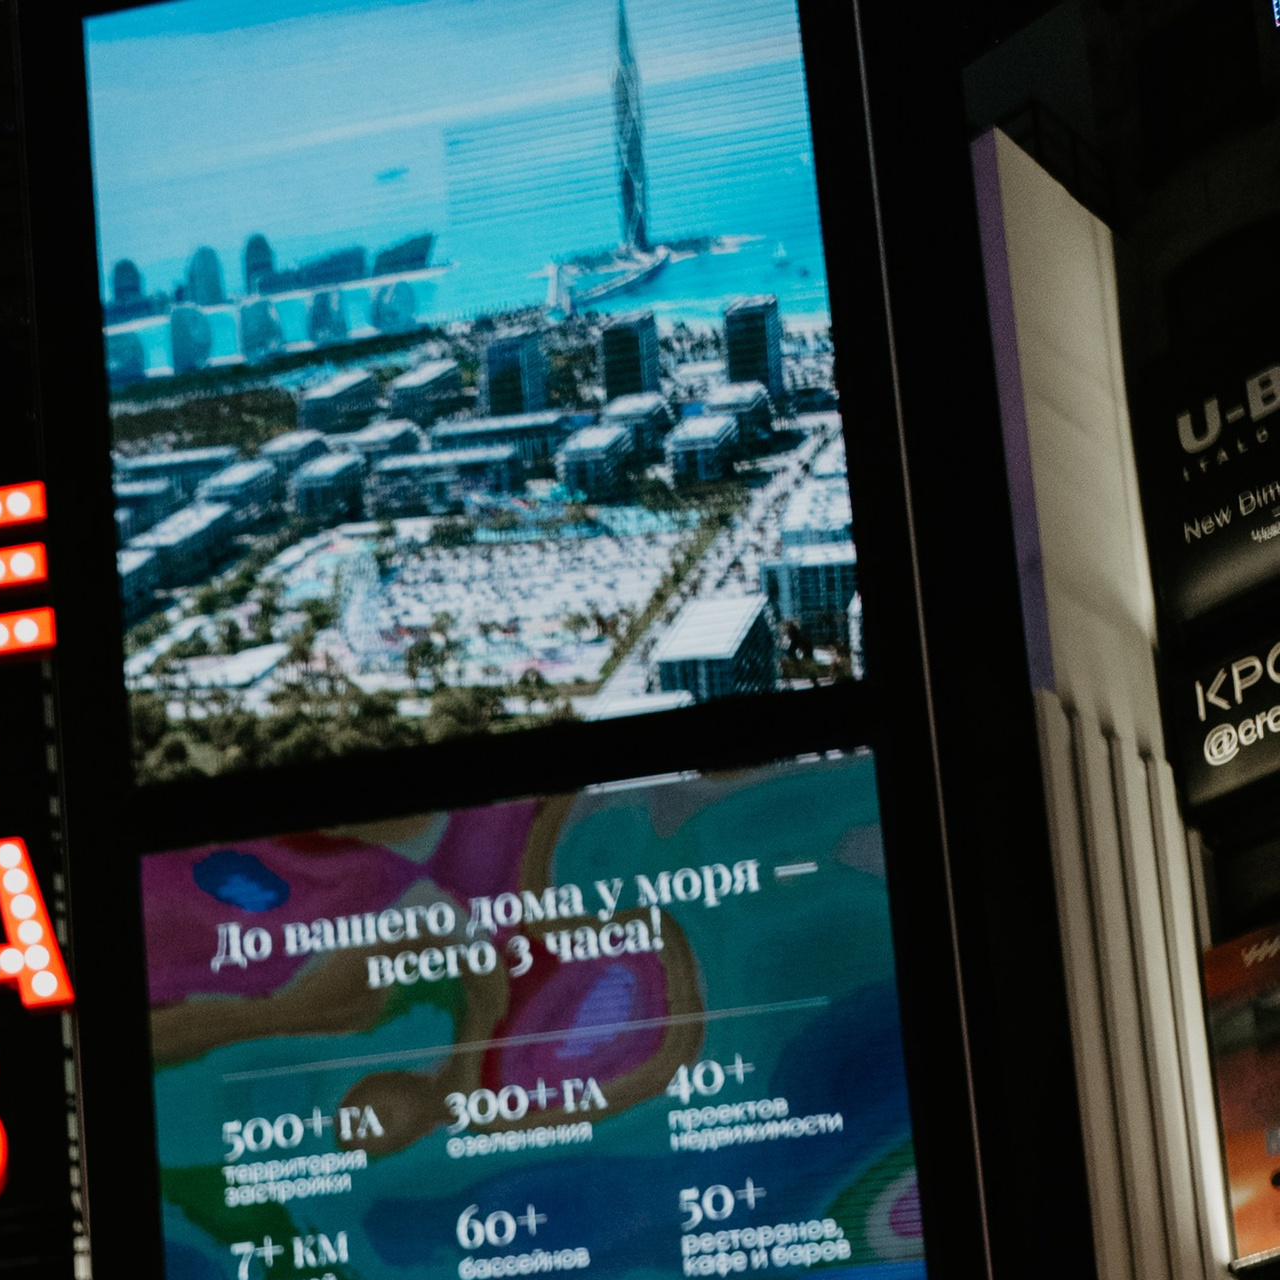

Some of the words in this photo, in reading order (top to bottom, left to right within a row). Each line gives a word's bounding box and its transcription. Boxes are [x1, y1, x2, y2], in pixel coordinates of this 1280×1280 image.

[1183, 504, 1232, 544] New
[210, 922, 273, 973] До
[283, 901, 456, 956] вашего
[466, 883, 586, 938] дома
[594, 878, 623, 922] у
[635, 859, 762, 908] моря
[367, 940, 497, 989] всего
[507, 935, 533, 978] 3
[543, 905, 665, 963] часа!
[666, 1053, 756, 1105] 40+
[444, 1076, 558, 1135] 300+
[668, 1097, 789, 1131] проектов
[222, 1106, 334, 1163] 500+
[446, 1121, 593, 1159] озеленения
[670, 1112, 844, 1152] недвижимости
[224, 1173, 352, 1208] застройки
[679, 1177, 767, 1231] 50+
[456, 1203, 548, 1249] 60+
[292, 1231, 349, 1269] КМ
[458, 1247, 591, 1280] бассейнов
[683, 1250, 748, 1278] кафе
[750, 1248, 769, 1270] и
[771, 1239, 852, 1268] баров
